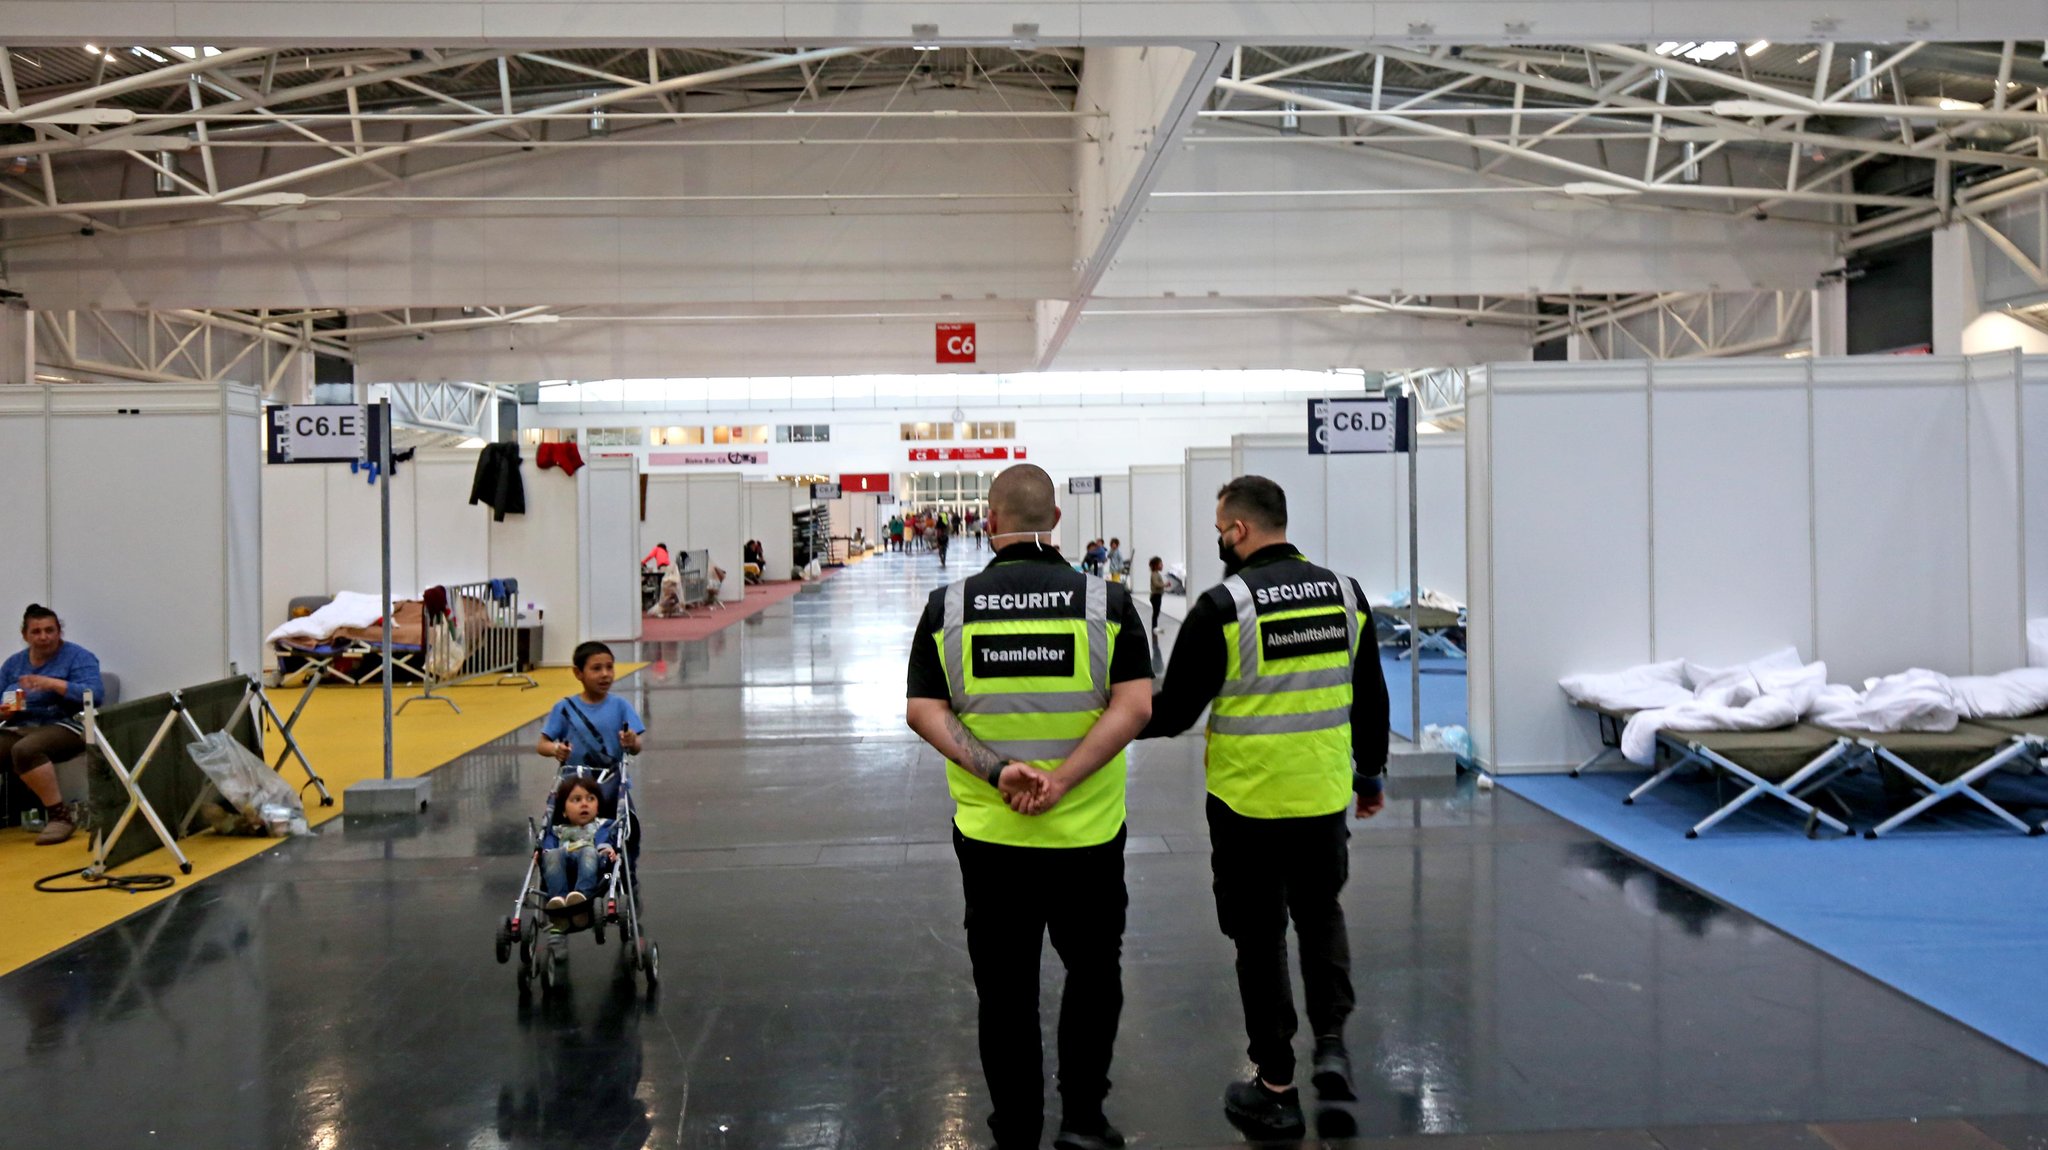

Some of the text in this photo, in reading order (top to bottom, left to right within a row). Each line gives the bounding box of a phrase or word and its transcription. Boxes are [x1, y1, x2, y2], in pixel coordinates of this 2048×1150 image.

[947, 335, 975, 355] C6
[296, 416, 356, 436] C6.E
[1333, 412, 1386, 431] C6.D
[973, 591, 1074, 610] SECURITY
[1256, 581, 1338, 605] SECURITY
[1267, 625, 1347, 648] Abschnittsleiter
[981, 647, 1066, 662] Teamleiter
